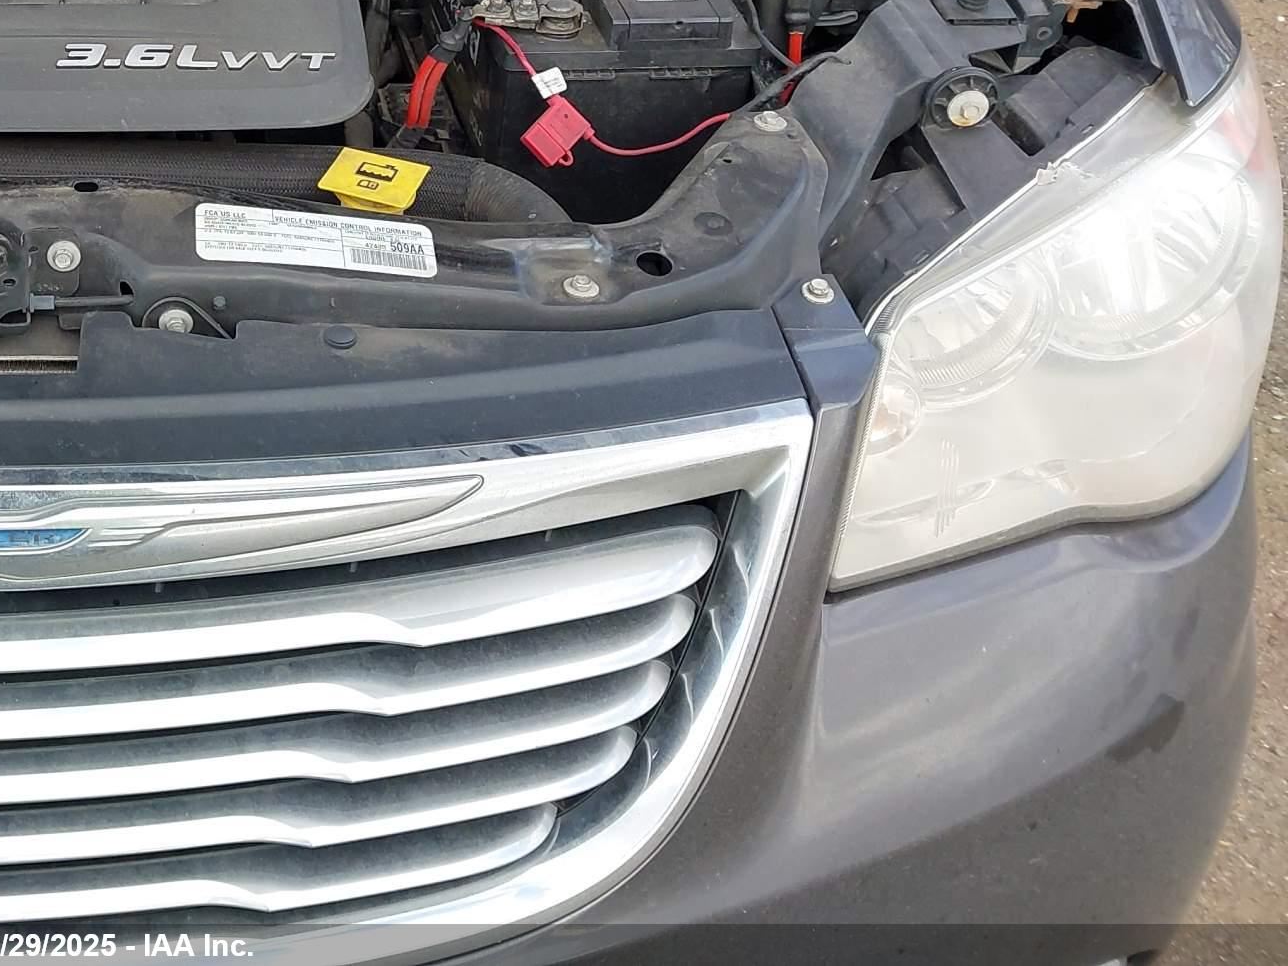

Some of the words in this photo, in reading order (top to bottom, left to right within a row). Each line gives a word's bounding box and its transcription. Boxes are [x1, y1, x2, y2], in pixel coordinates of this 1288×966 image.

[56, 43, 218, 70] 3.6L
[221, 51, 336, 71] VVT
[274, 216, 302, 224] VEHICLE
[305, 219, 338, 228] EMISSION
[340, 222, 372, 231] CONTROL
[374, 225, 422, 237] INFORMATION
[390, 242, 425, 255] 509AA
